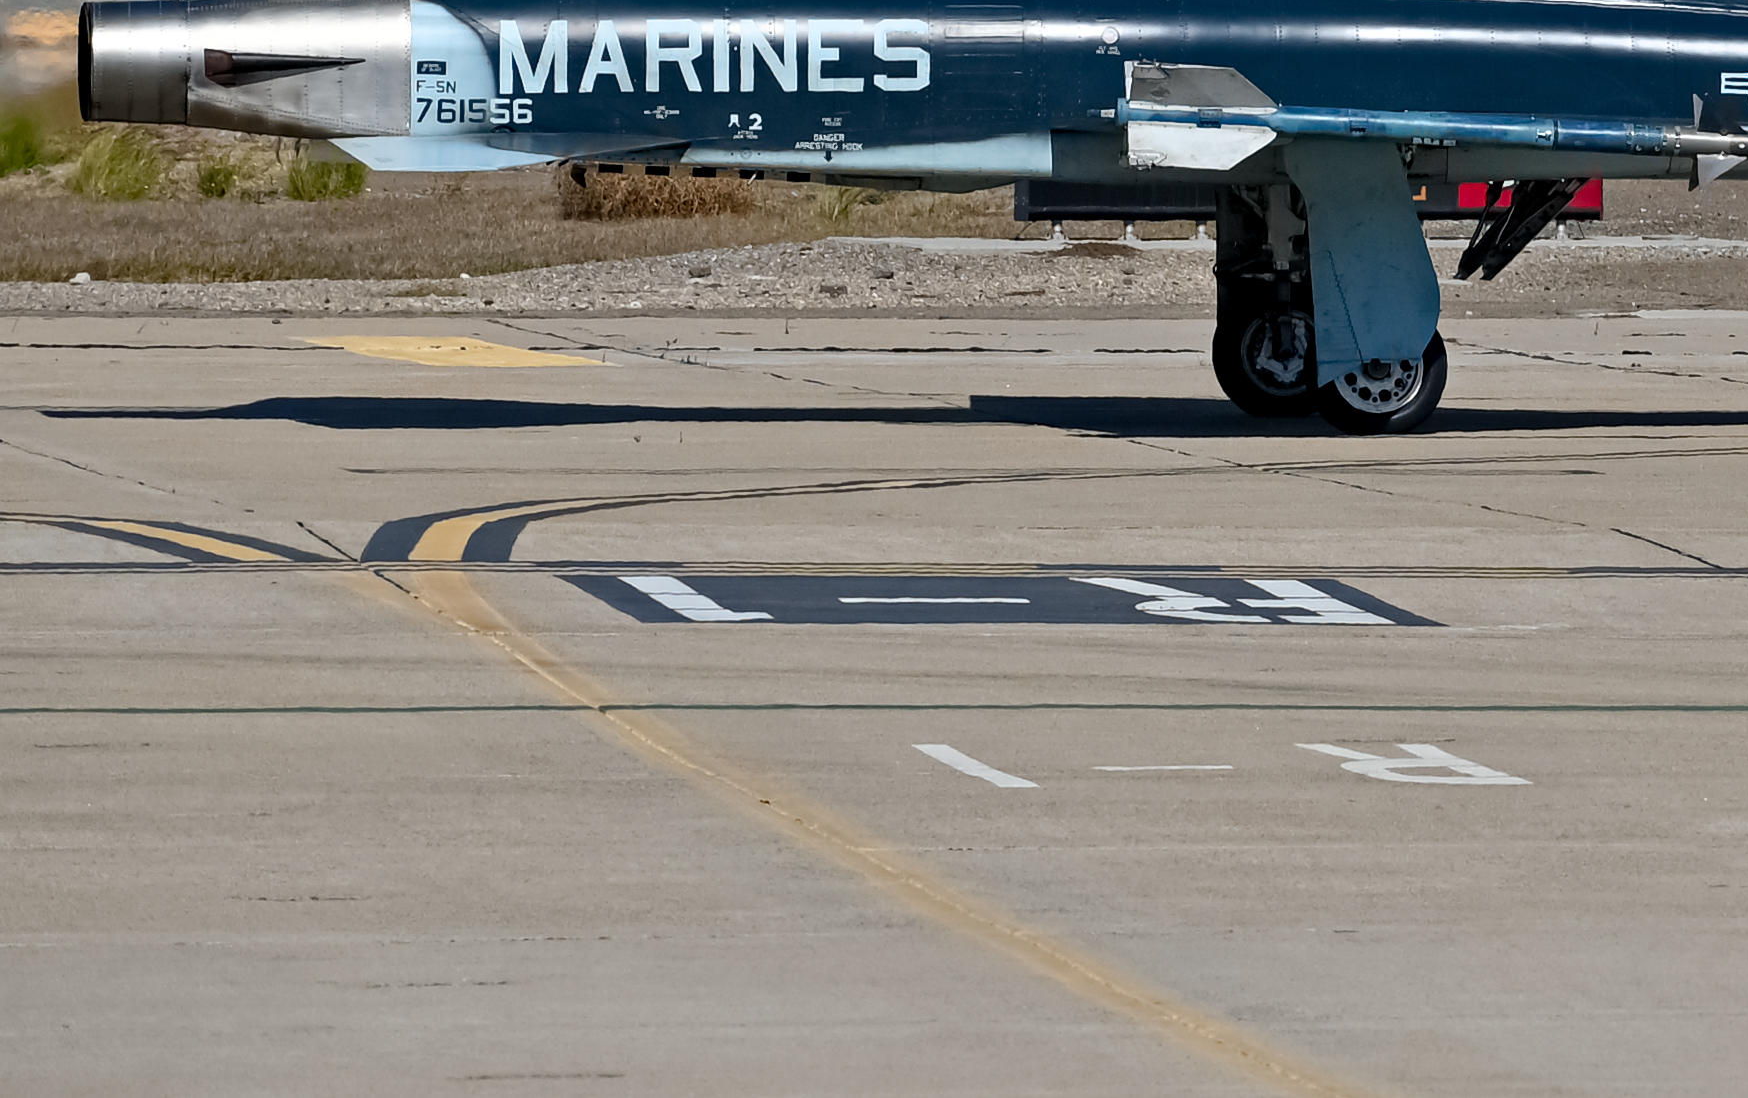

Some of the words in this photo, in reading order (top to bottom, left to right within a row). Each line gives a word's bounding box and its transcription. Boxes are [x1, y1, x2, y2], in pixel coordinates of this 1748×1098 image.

[499, 19, 931, 94] MARINES
[416, 80, 457, 94] F-5N
[416, 97, 534, 124] 761556
[748, 113, 763, 130] 2
